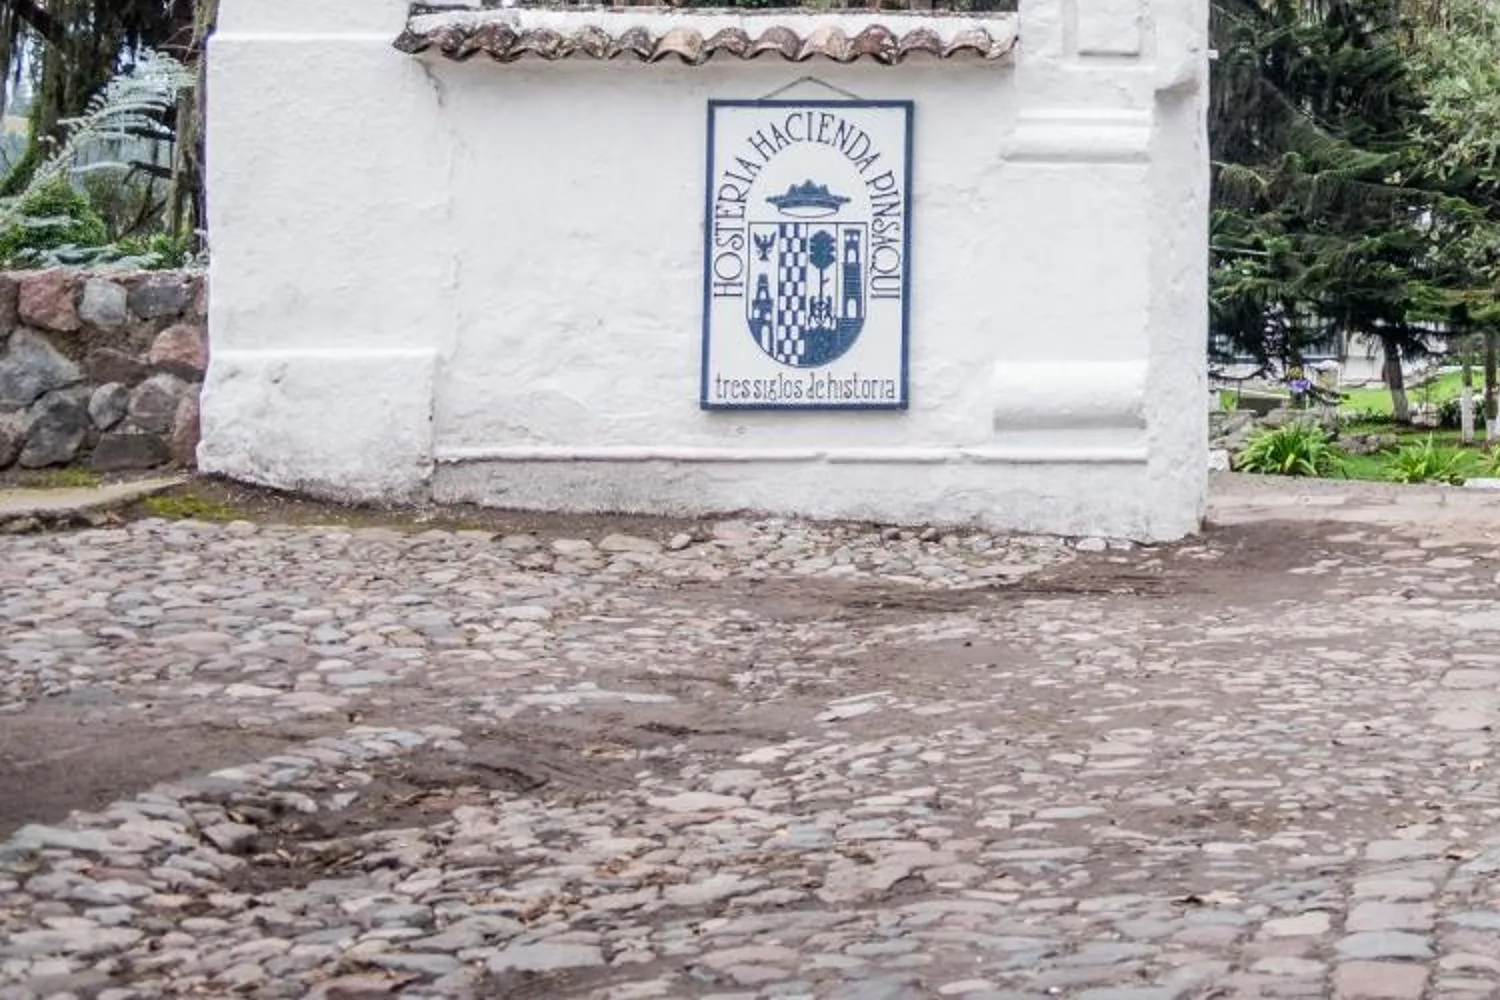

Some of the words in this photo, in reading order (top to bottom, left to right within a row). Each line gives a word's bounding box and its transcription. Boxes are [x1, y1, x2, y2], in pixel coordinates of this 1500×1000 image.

[713, 154, 762, 297] HOSTERIA
[747, 111, 882, 174] HACIENDA
[864, 170, 900, 299] PINSAQUI
[715, 373, 749, 399] tres
[752, 373, 803, 401] siglos
[806, 371, 825, 399] de
[826, 373, 896, 400] historia
